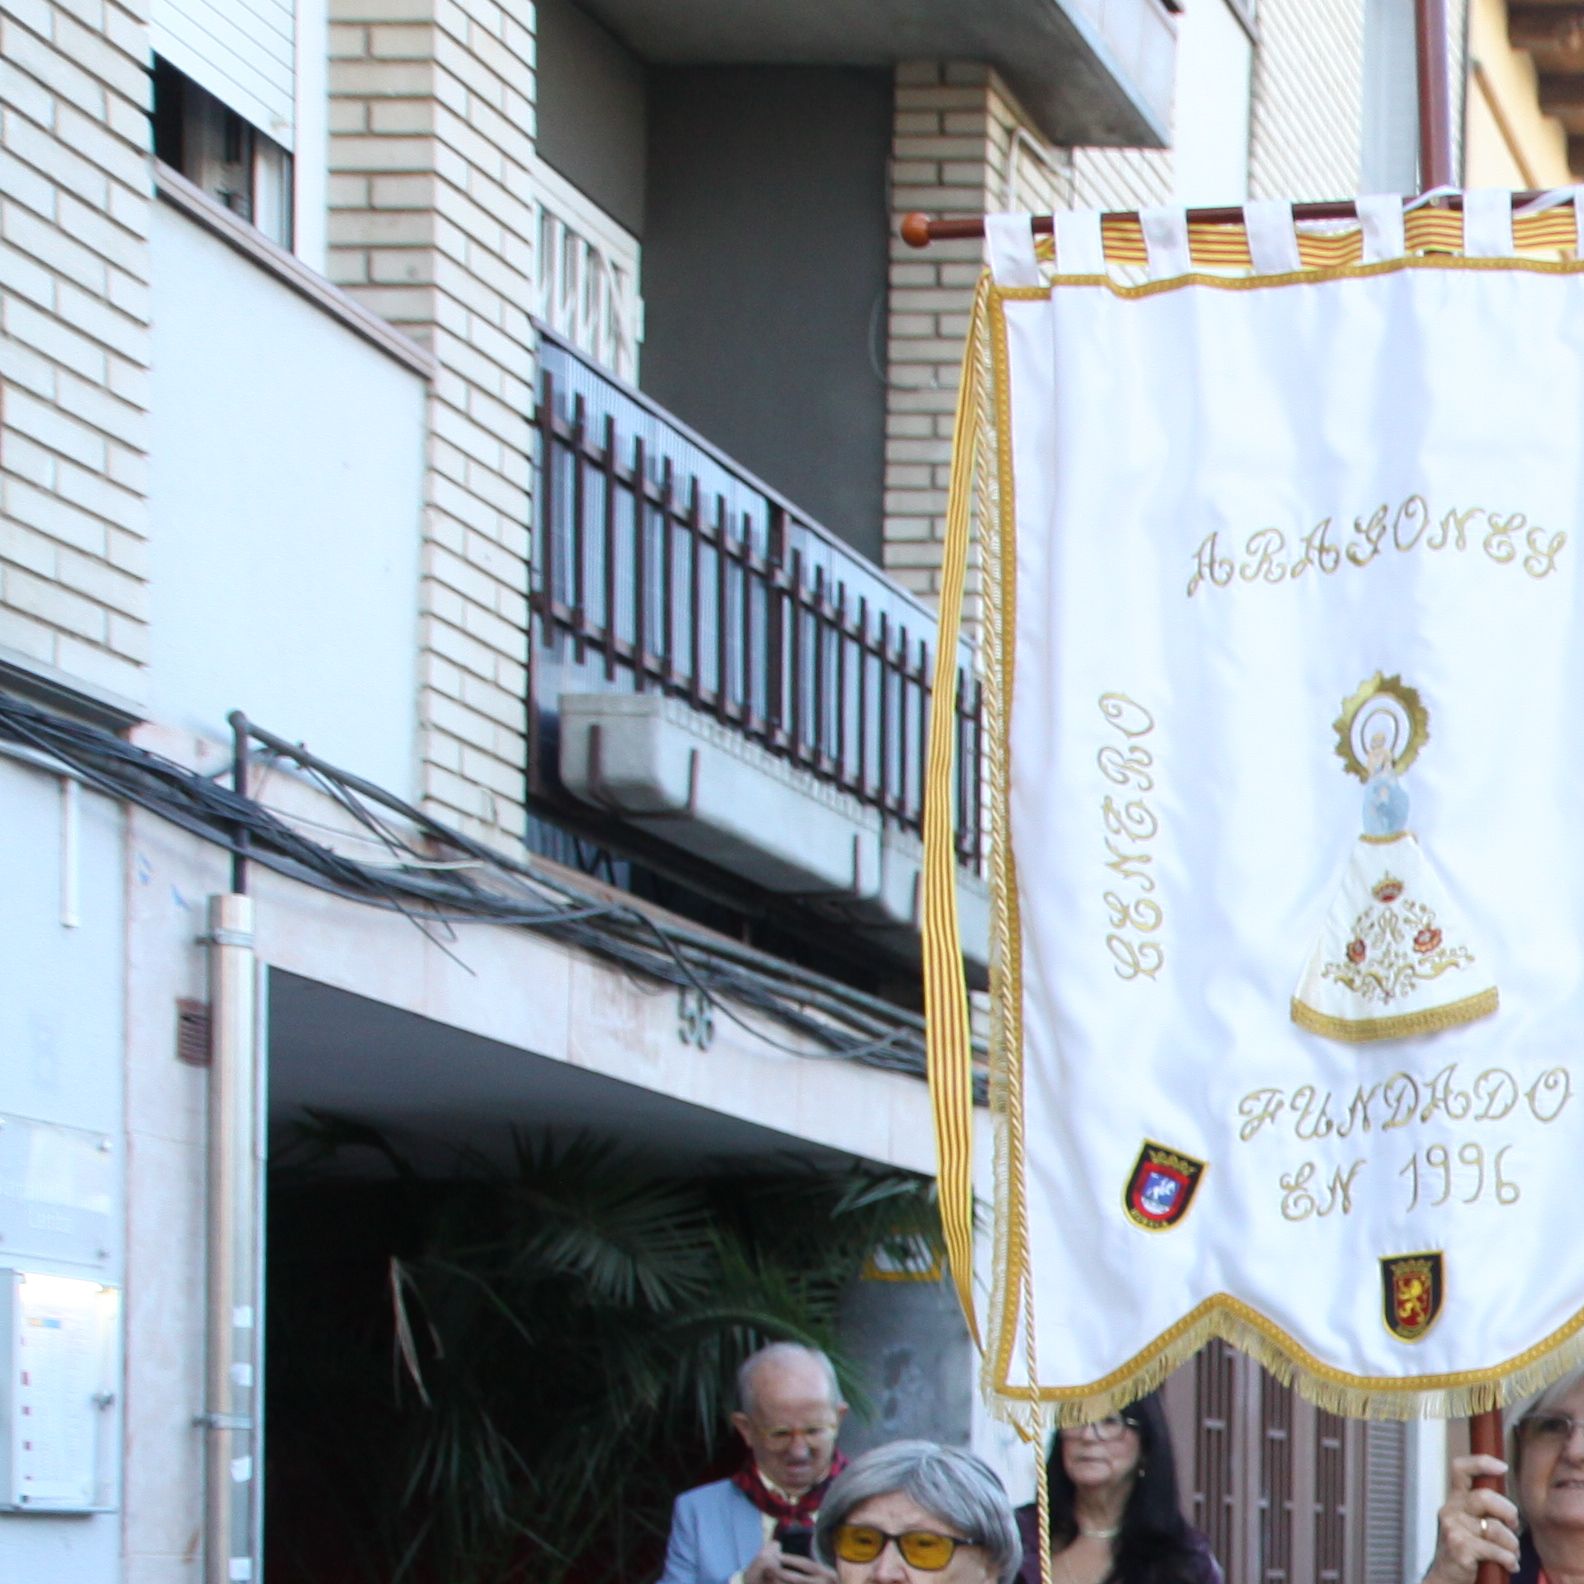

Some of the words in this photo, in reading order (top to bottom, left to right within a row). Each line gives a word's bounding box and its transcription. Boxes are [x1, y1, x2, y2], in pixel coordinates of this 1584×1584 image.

[1187, 494, 1566, 597] ARAGONES
[1238, 1062, 1573, 1141] FUNDADO
[1279, 1159, 1367, 1221] EN
[1399, 1142, 1520, 1212] 1996
